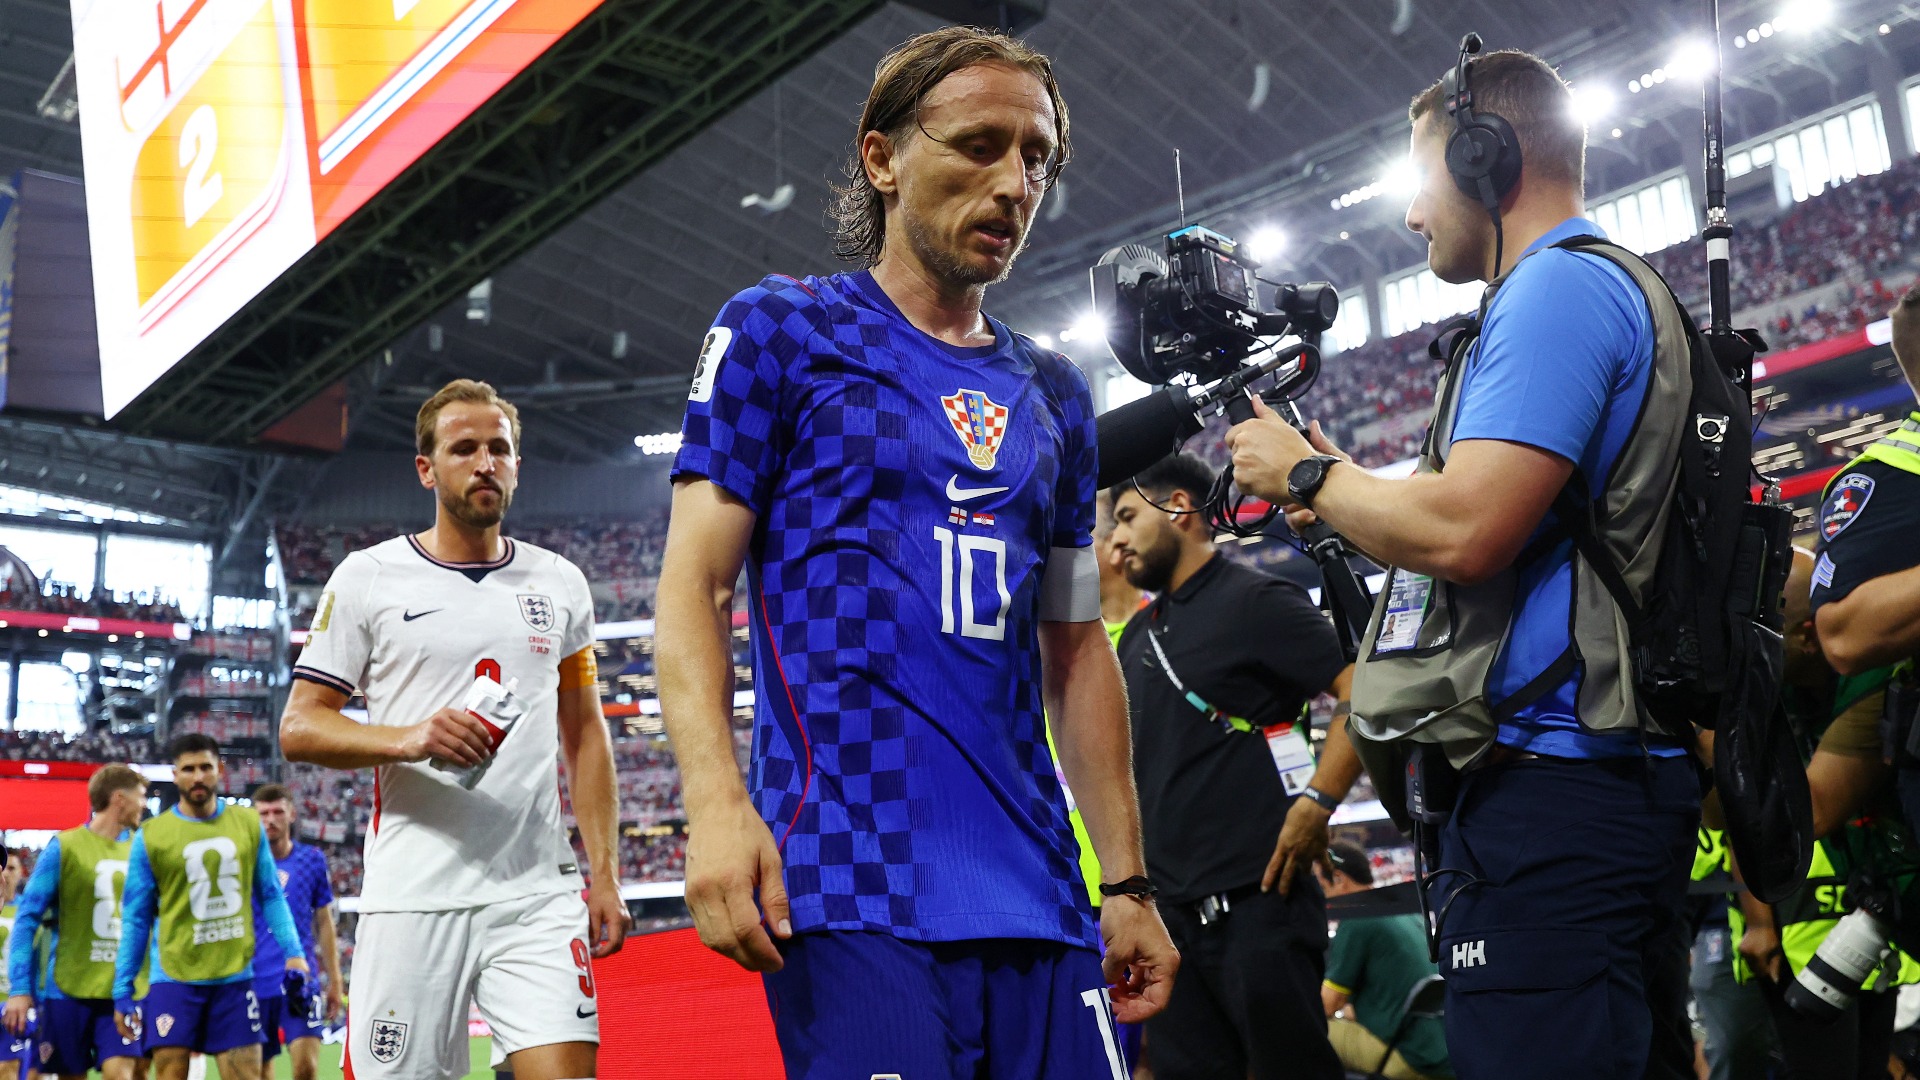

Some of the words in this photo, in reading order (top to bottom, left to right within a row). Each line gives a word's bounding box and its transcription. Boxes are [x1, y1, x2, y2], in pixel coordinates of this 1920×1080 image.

[178, 105, 223, 228] 2
[934, 526, 1011, 641] 10
[570, 938, 595, 998] 9
[1452, 940, 1486, 969] HH
